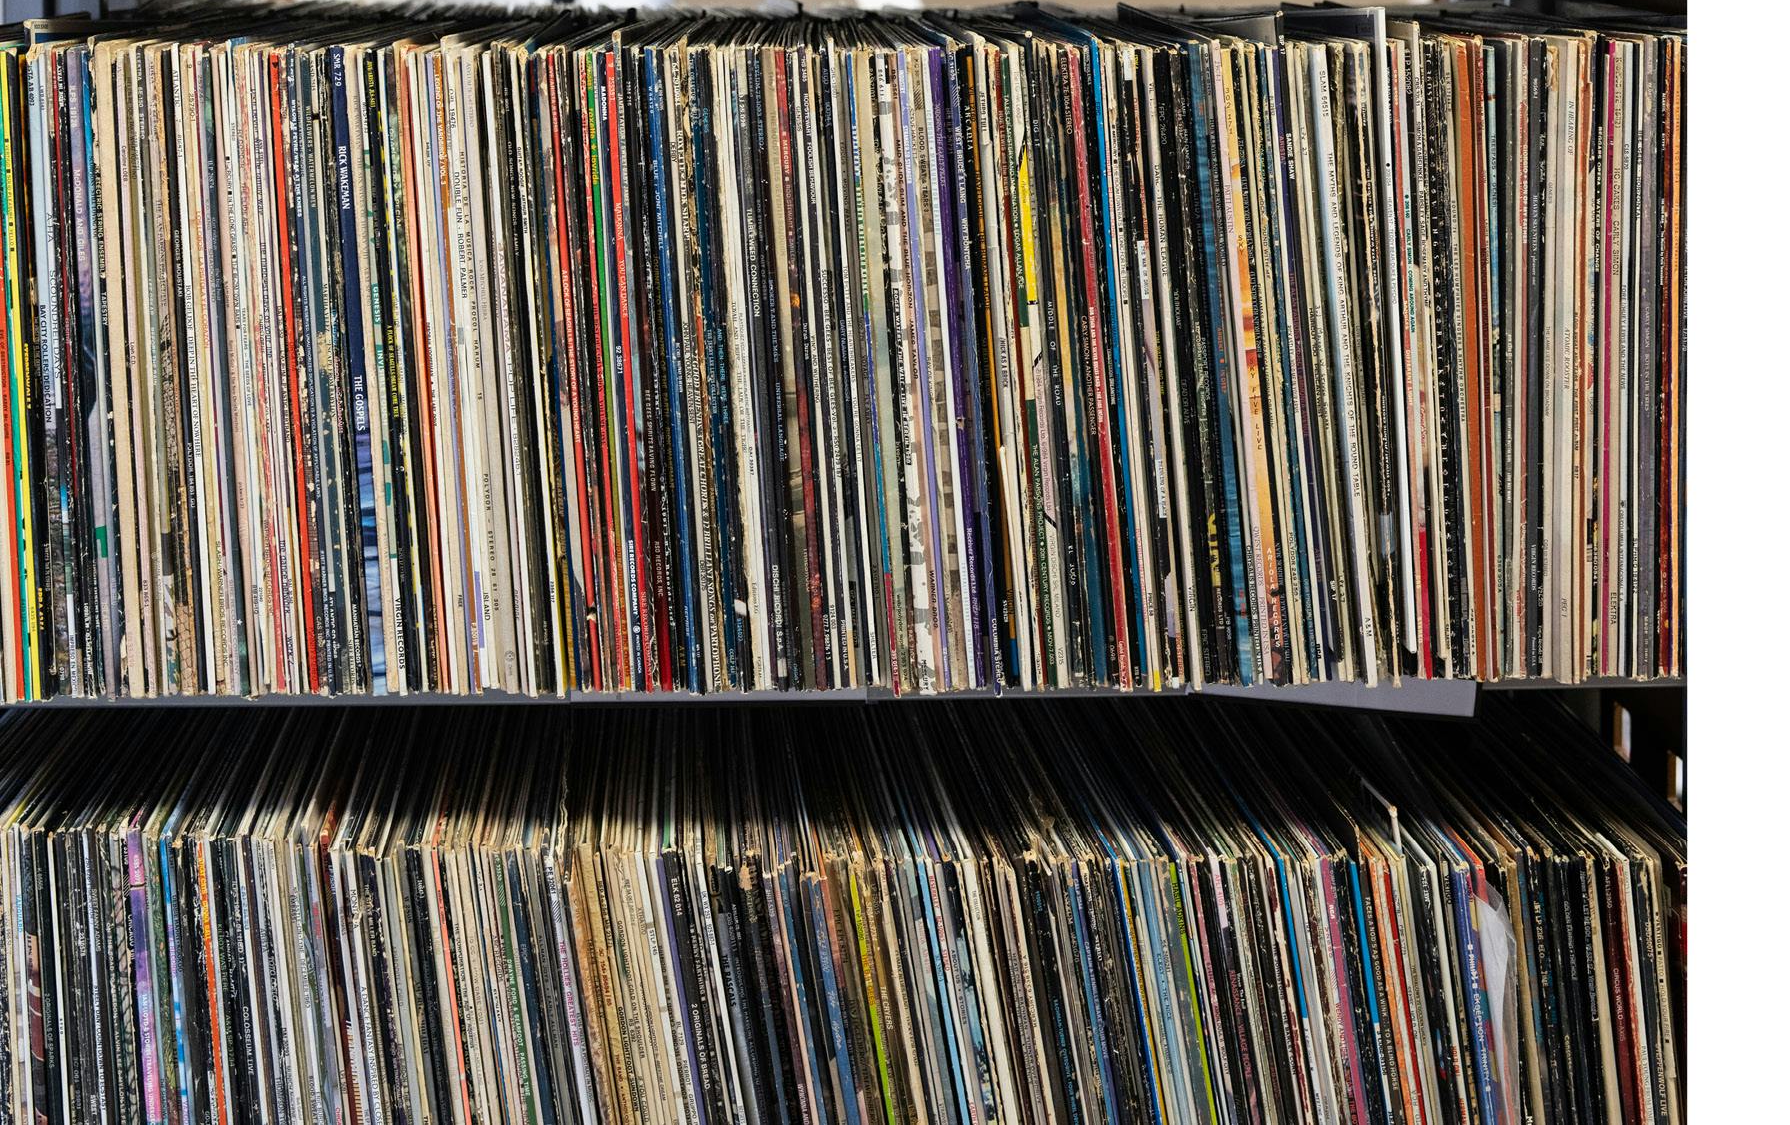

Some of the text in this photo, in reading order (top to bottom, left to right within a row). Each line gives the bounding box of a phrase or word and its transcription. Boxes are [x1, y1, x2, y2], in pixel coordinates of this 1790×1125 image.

[333, 54, 350, 209] SMR 729 RICK WAKEMAN
[74, 170, 82, 213] McDONALD
[454, 172, 462, 203] DOUBLE
[457, 234, 465, 264] ROBERT
[460, 268, 468, 298] PALMER
[1336, 262, 1342, 273] OF
[373, 287, 381, 322] GENESIS
[242, 1006, 252, 1055] COLOSSEUM
[692, 1010, 702, 1050] ORIGINALS
[698, 1052, 705, 1062] OF
